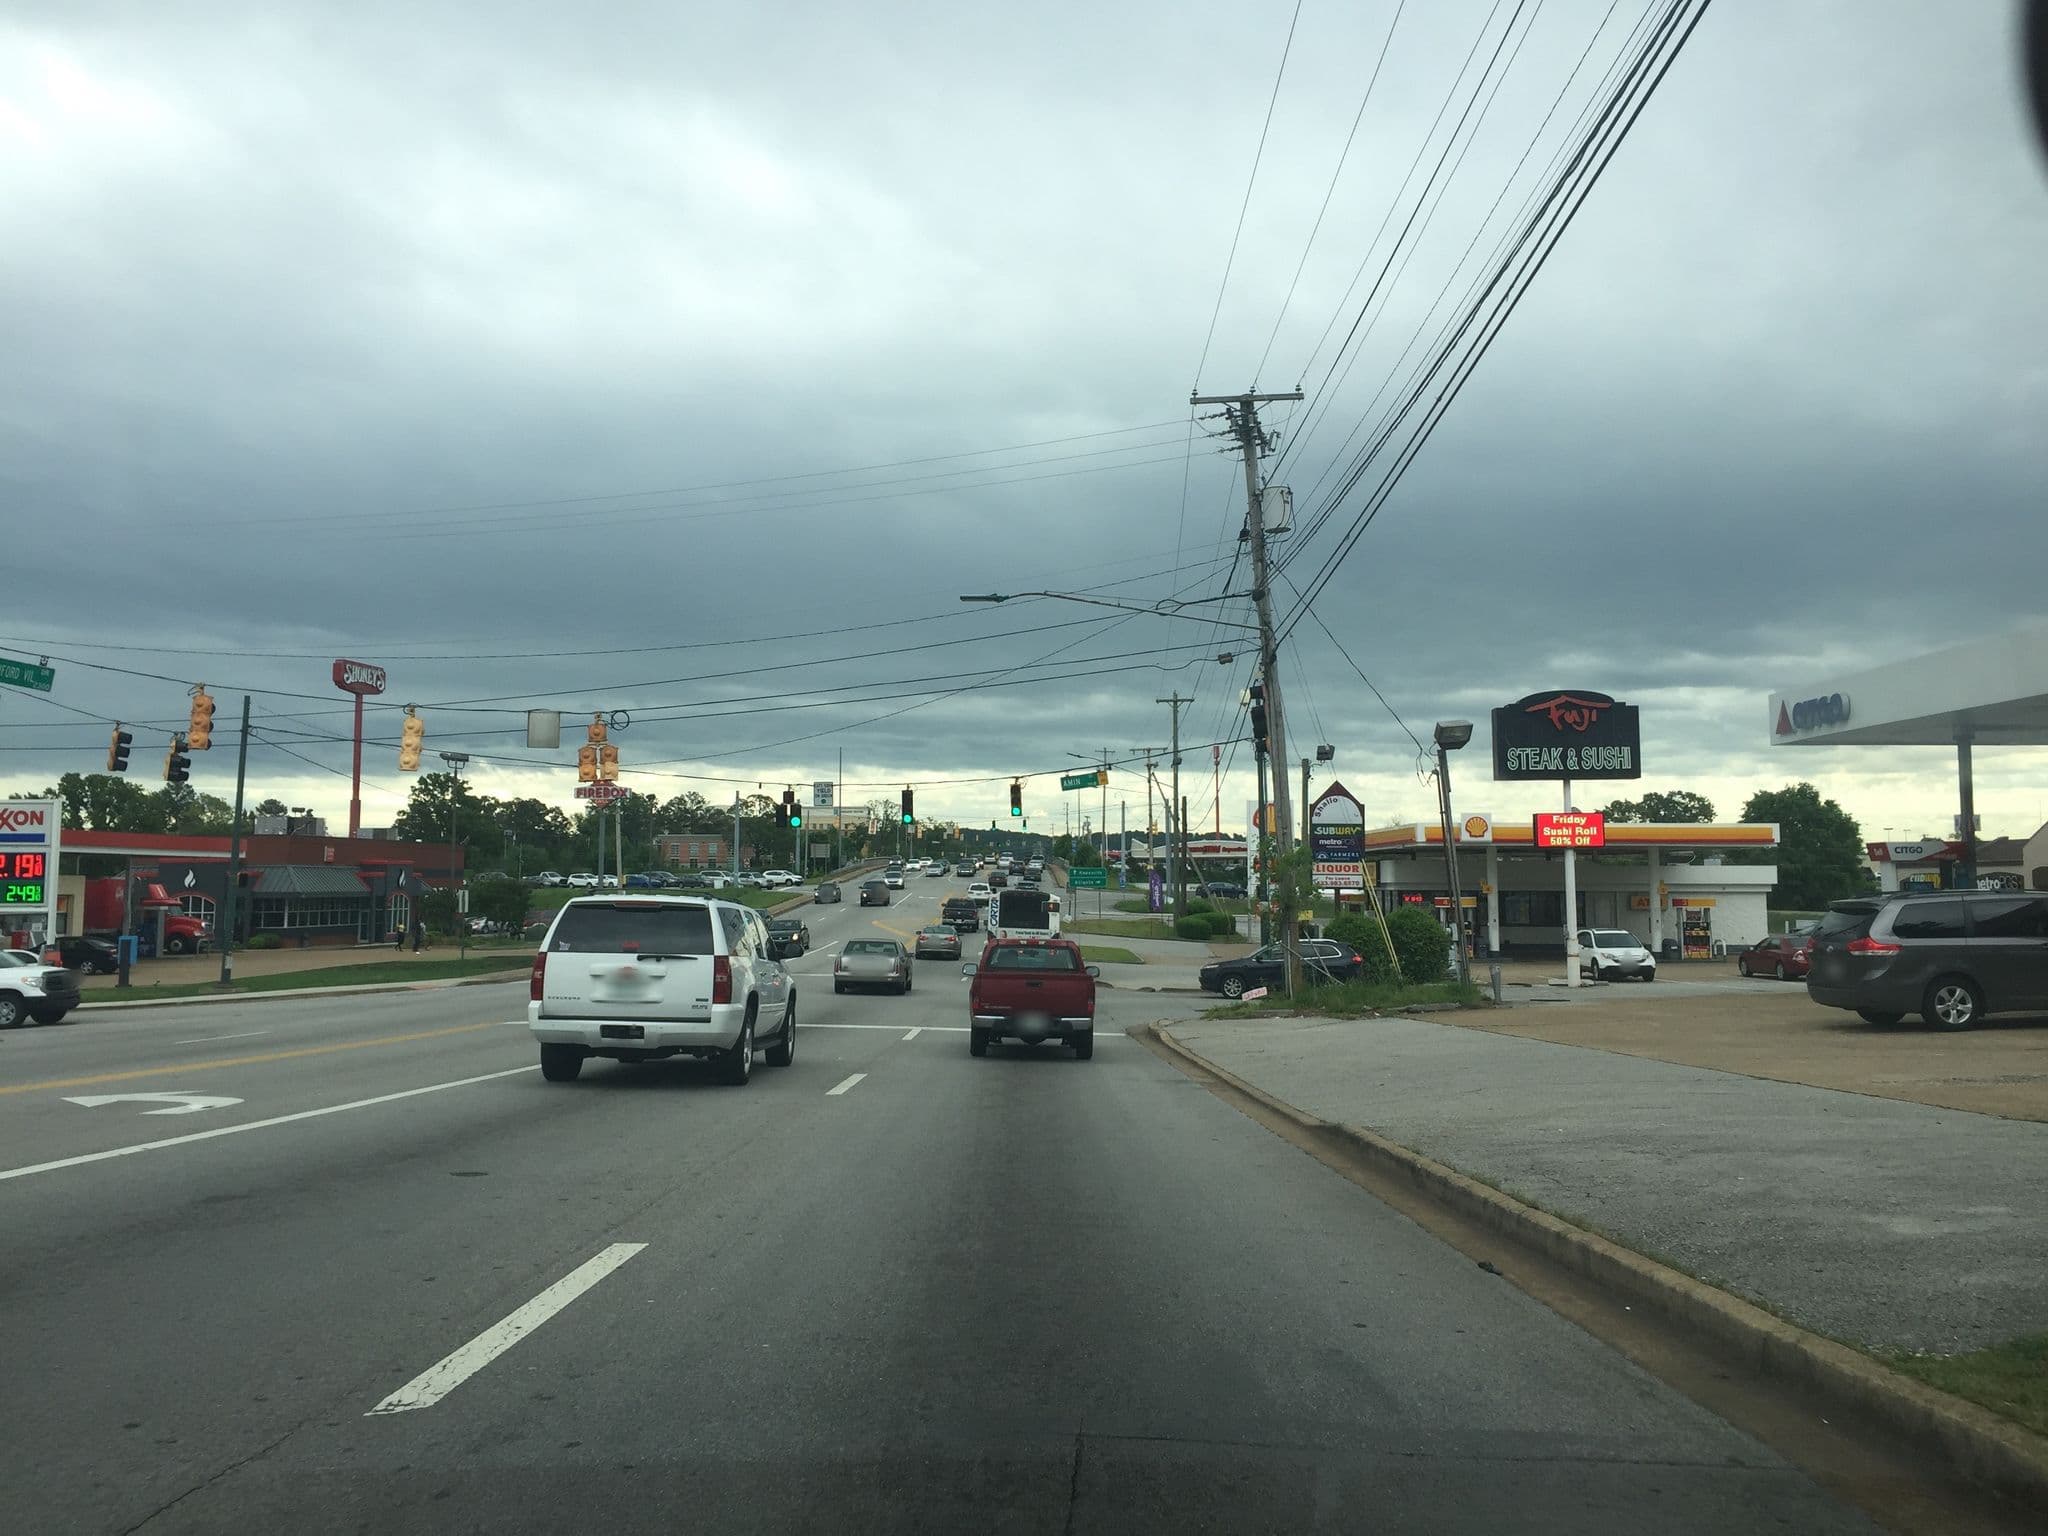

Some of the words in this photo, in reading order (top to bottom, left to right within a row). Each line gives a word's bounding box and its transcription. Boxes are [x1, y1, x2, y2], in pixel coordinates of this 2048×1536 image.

[344, 664, 385, 691] SHONEY'S
[1507, 748, 1563, 770] STEAK
[1567, 748, 1579, 770] &
[1581, 747, 1632, 770] SUSHI
[576, 787, 629, 799] FIREBOX
[1552, 815, 1587, 825] Friday
[1314, 827, 1361, 835] SUBWAY
[1543, 827, 1572, 835] Sushi
[1575, 827, 1597, 835] Roll
[1550, 837, 1572, 845] 50%
[1575, 837, 1590, 845] Off
[1895, 846, 1923, 854] CITGO
[1316, 864, 1360, 873] LIQUOR
[990, 899, 999, 926] CARTA
